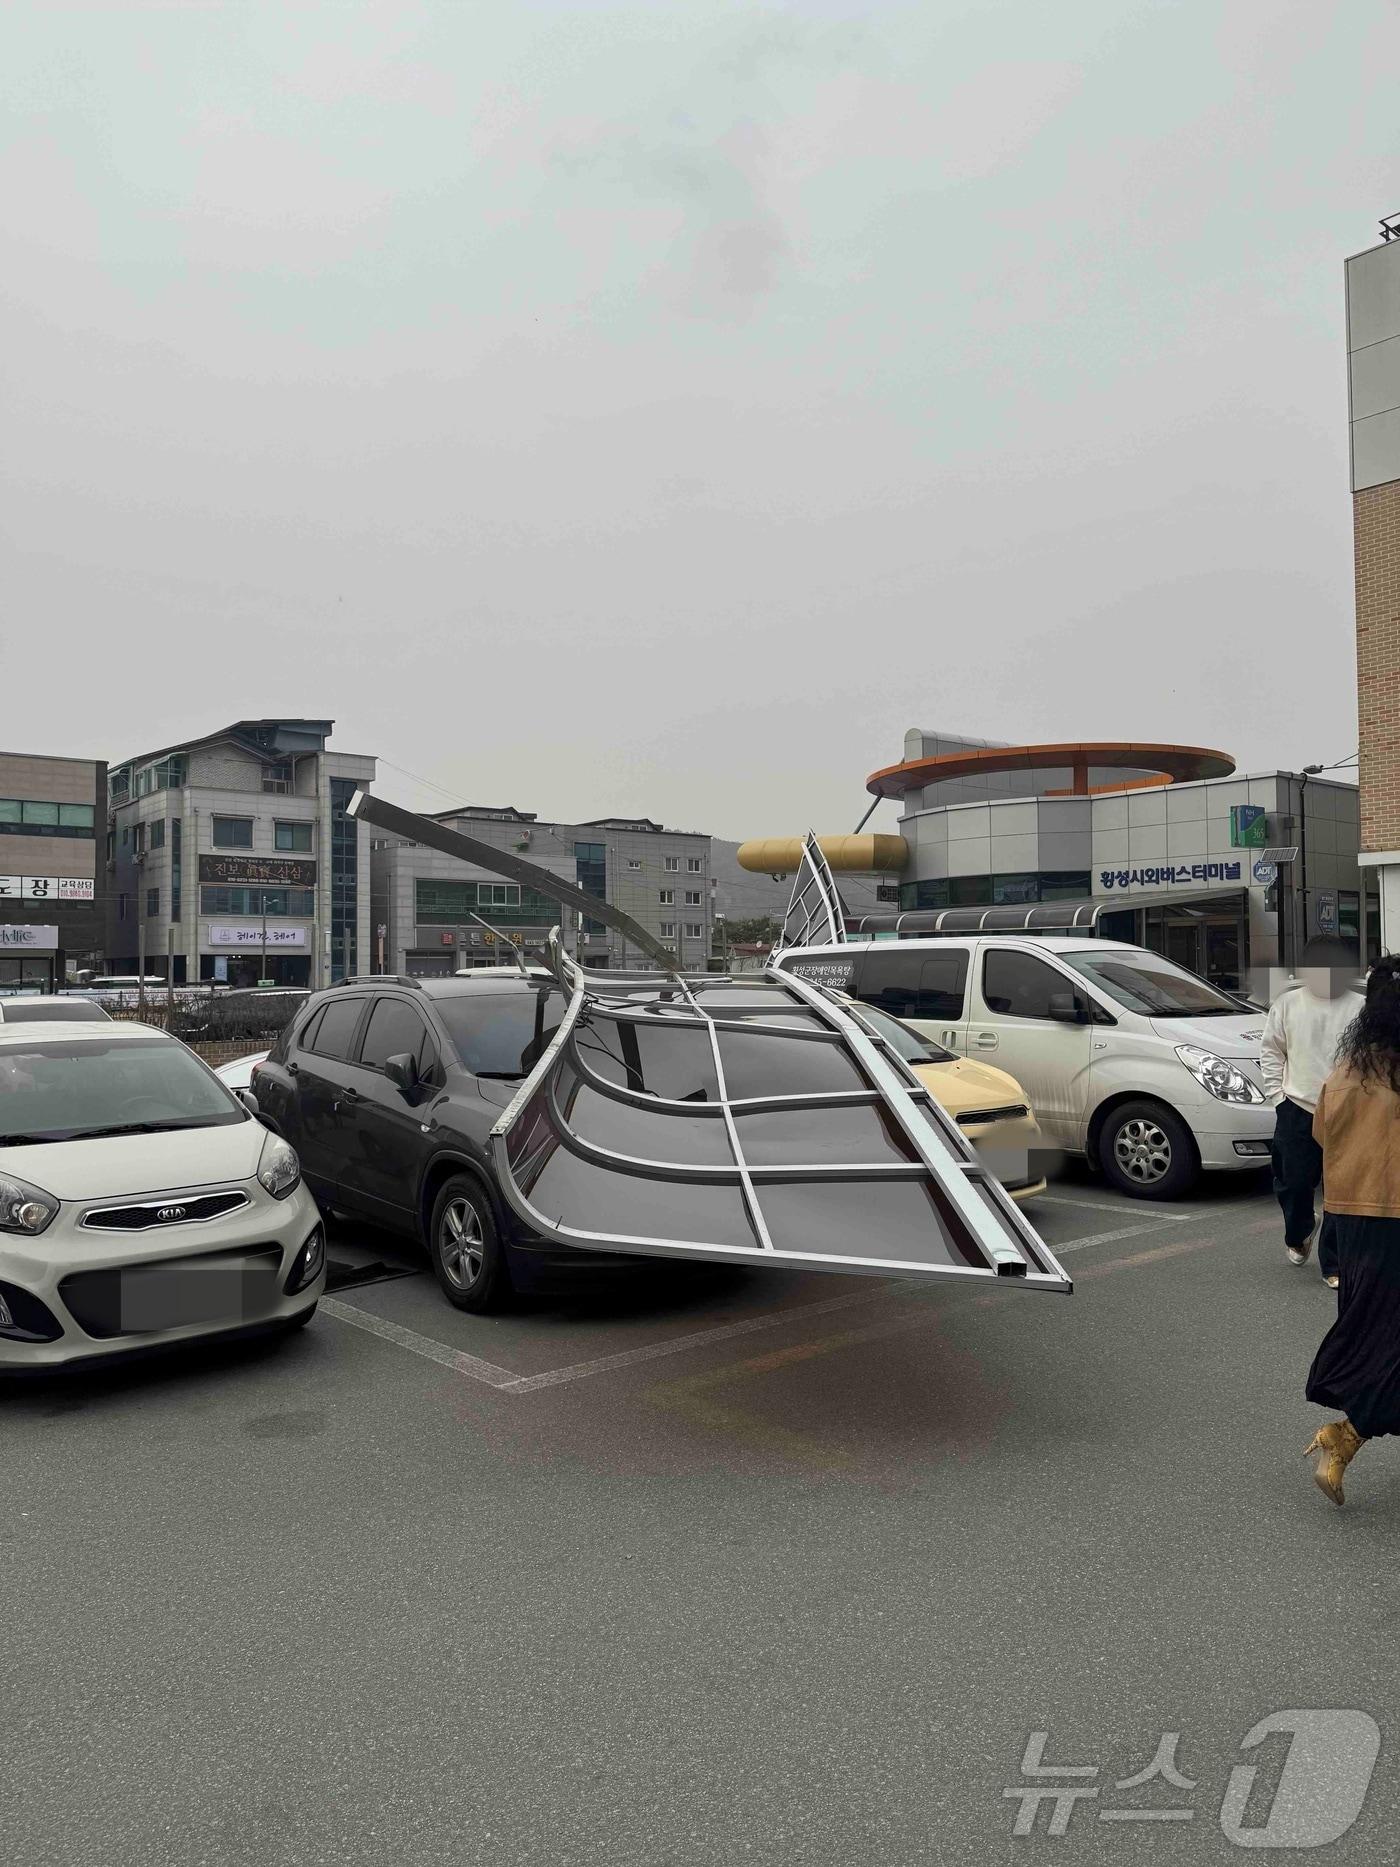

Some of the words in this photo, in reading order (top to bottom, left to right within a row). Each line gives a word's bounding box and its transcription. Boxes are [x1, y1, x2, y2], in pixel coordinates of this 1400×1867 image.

[1252, 827, 1264, 839] 365
[214, 862, 241, 876] 진보
[278, 865, 303, 879] 산삼
[1100, 861, 1241, 889] 횡성시외버스터미널
[1257, 867, 1271, 875] ADT
[61, 881, 92, 889] 교육상담
[162, 1208, 182, 1219] KIA
